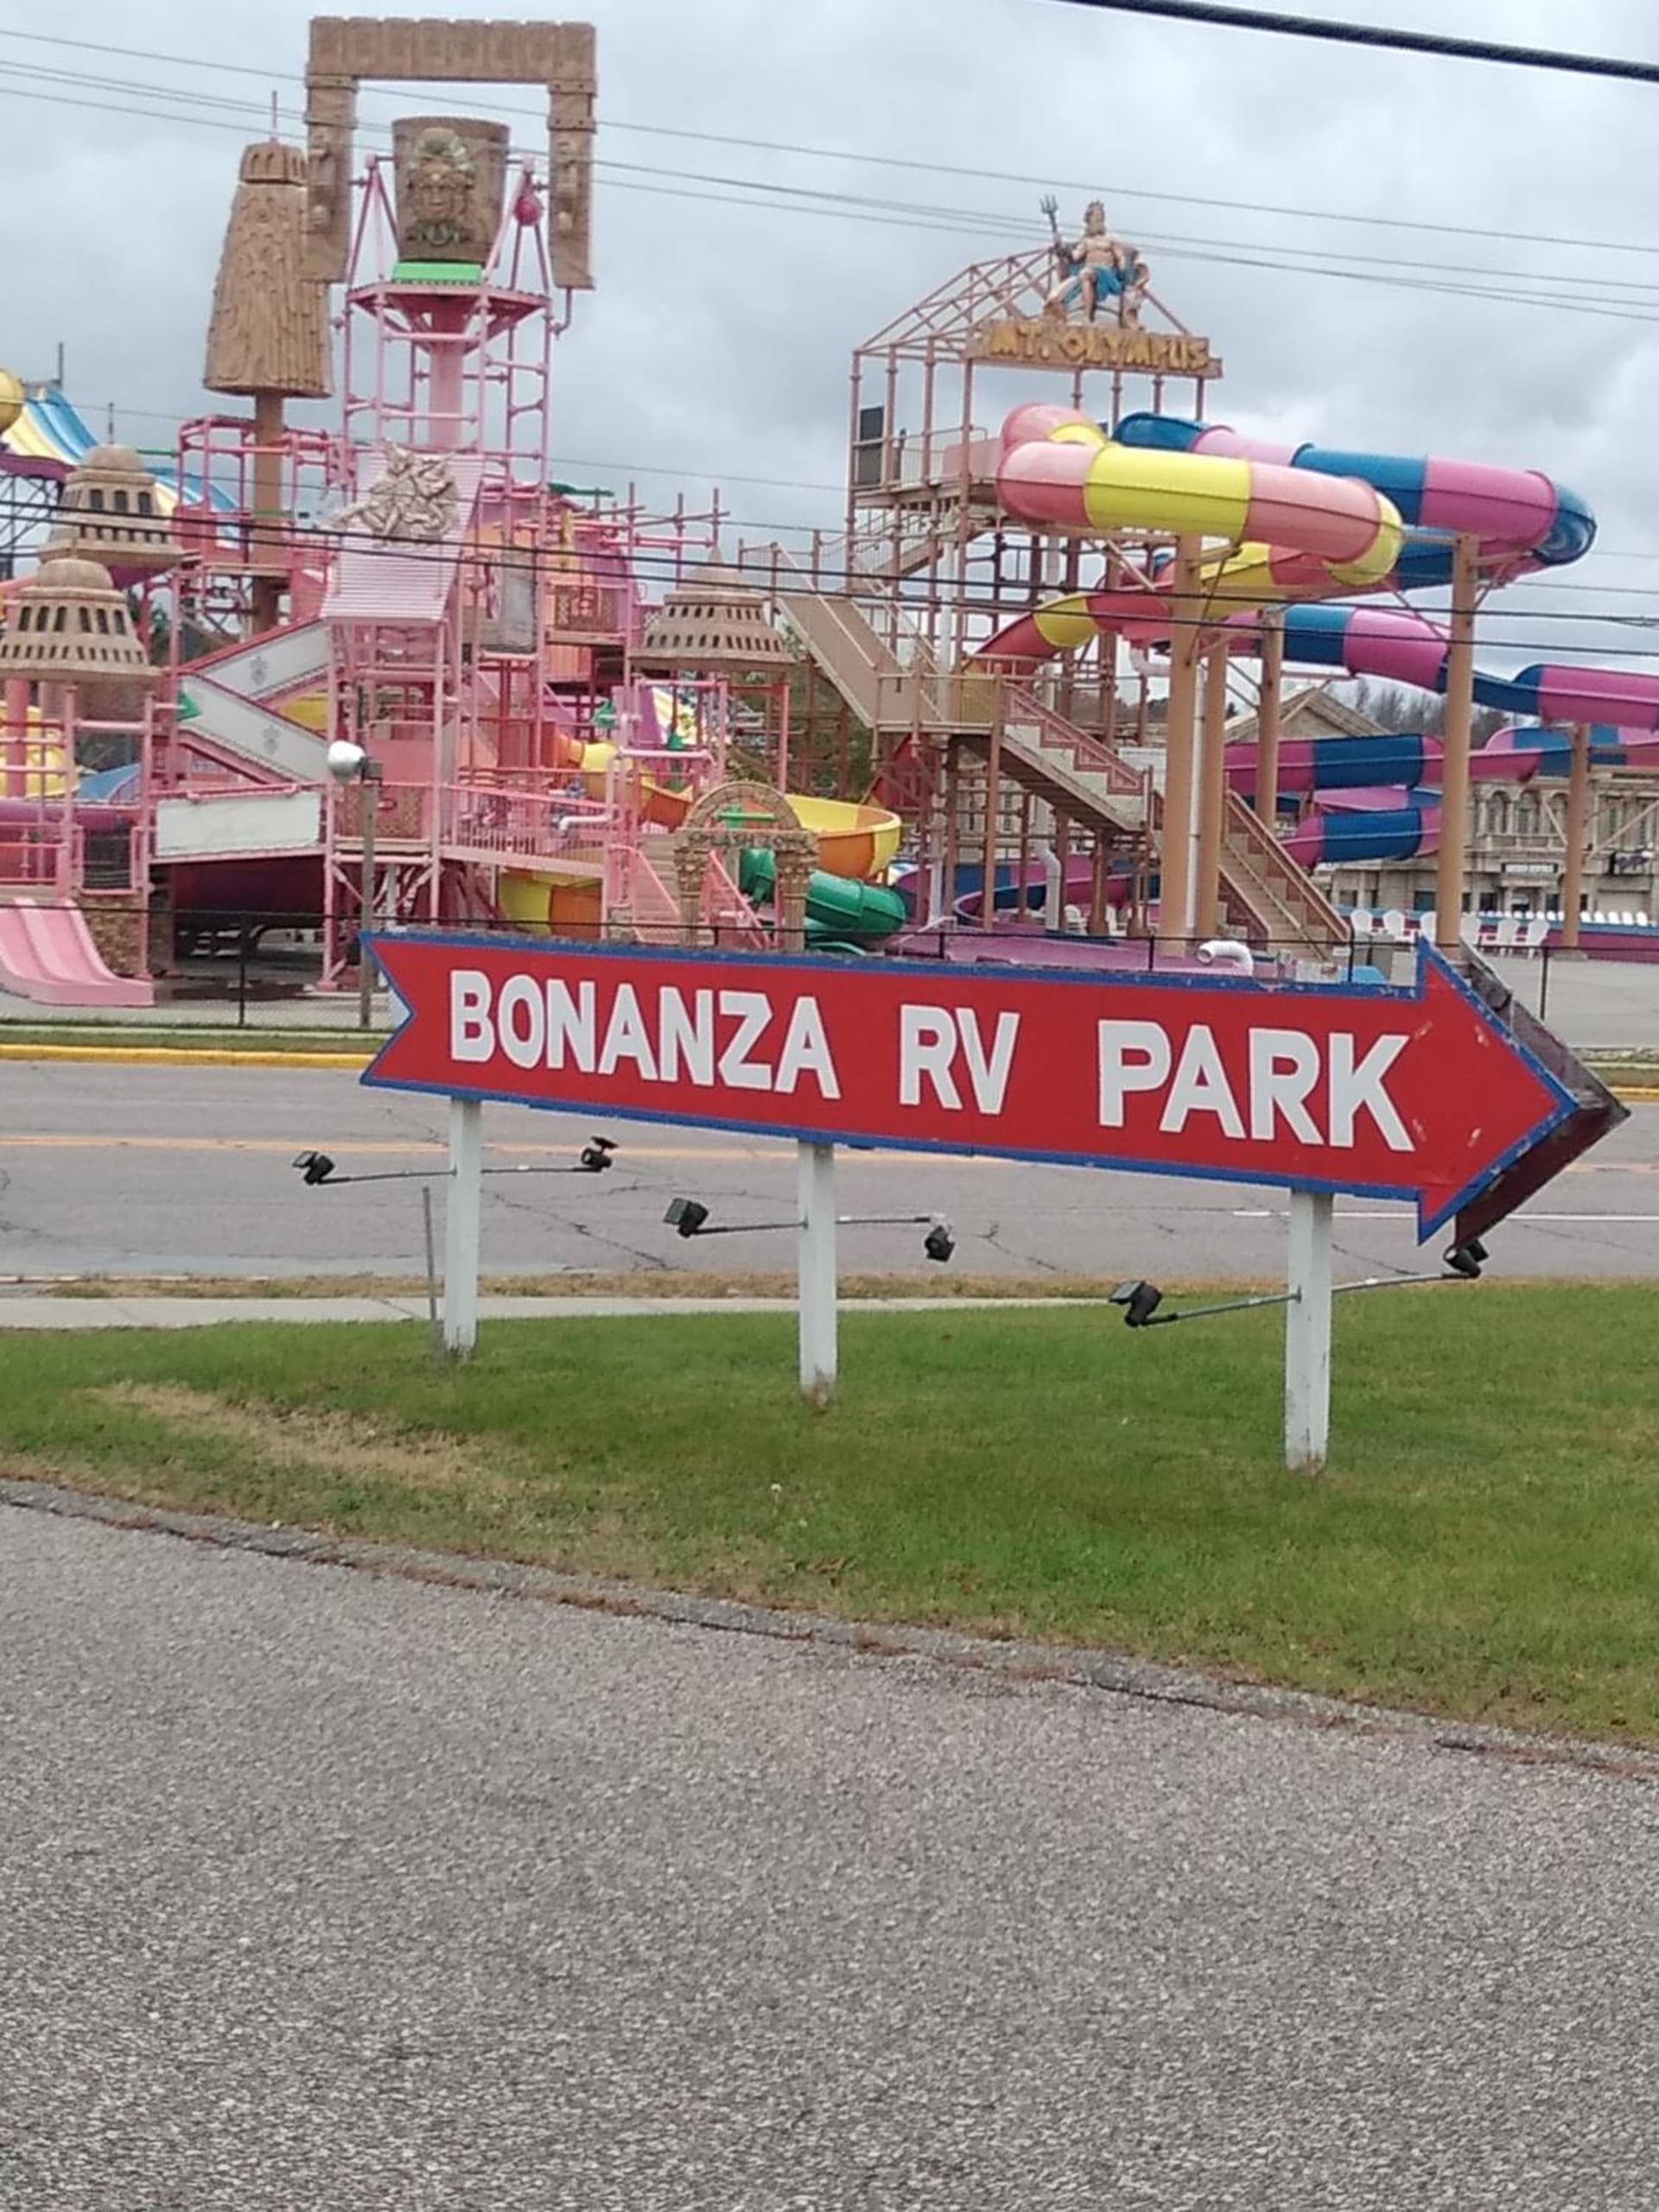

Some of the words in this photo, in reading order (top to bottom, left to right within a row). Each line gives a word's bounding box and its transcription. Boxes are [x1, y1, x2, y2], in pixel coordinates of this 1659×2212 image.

[990, 324, 1050, 359] MT.
[1060, 328, 1208, 371] OLYMPUS
[449, 969, 842, 1100] BONANZA
[899, 1003, 1020, 1116] RV
[1097, 1019, 1415, 1152] PARK
